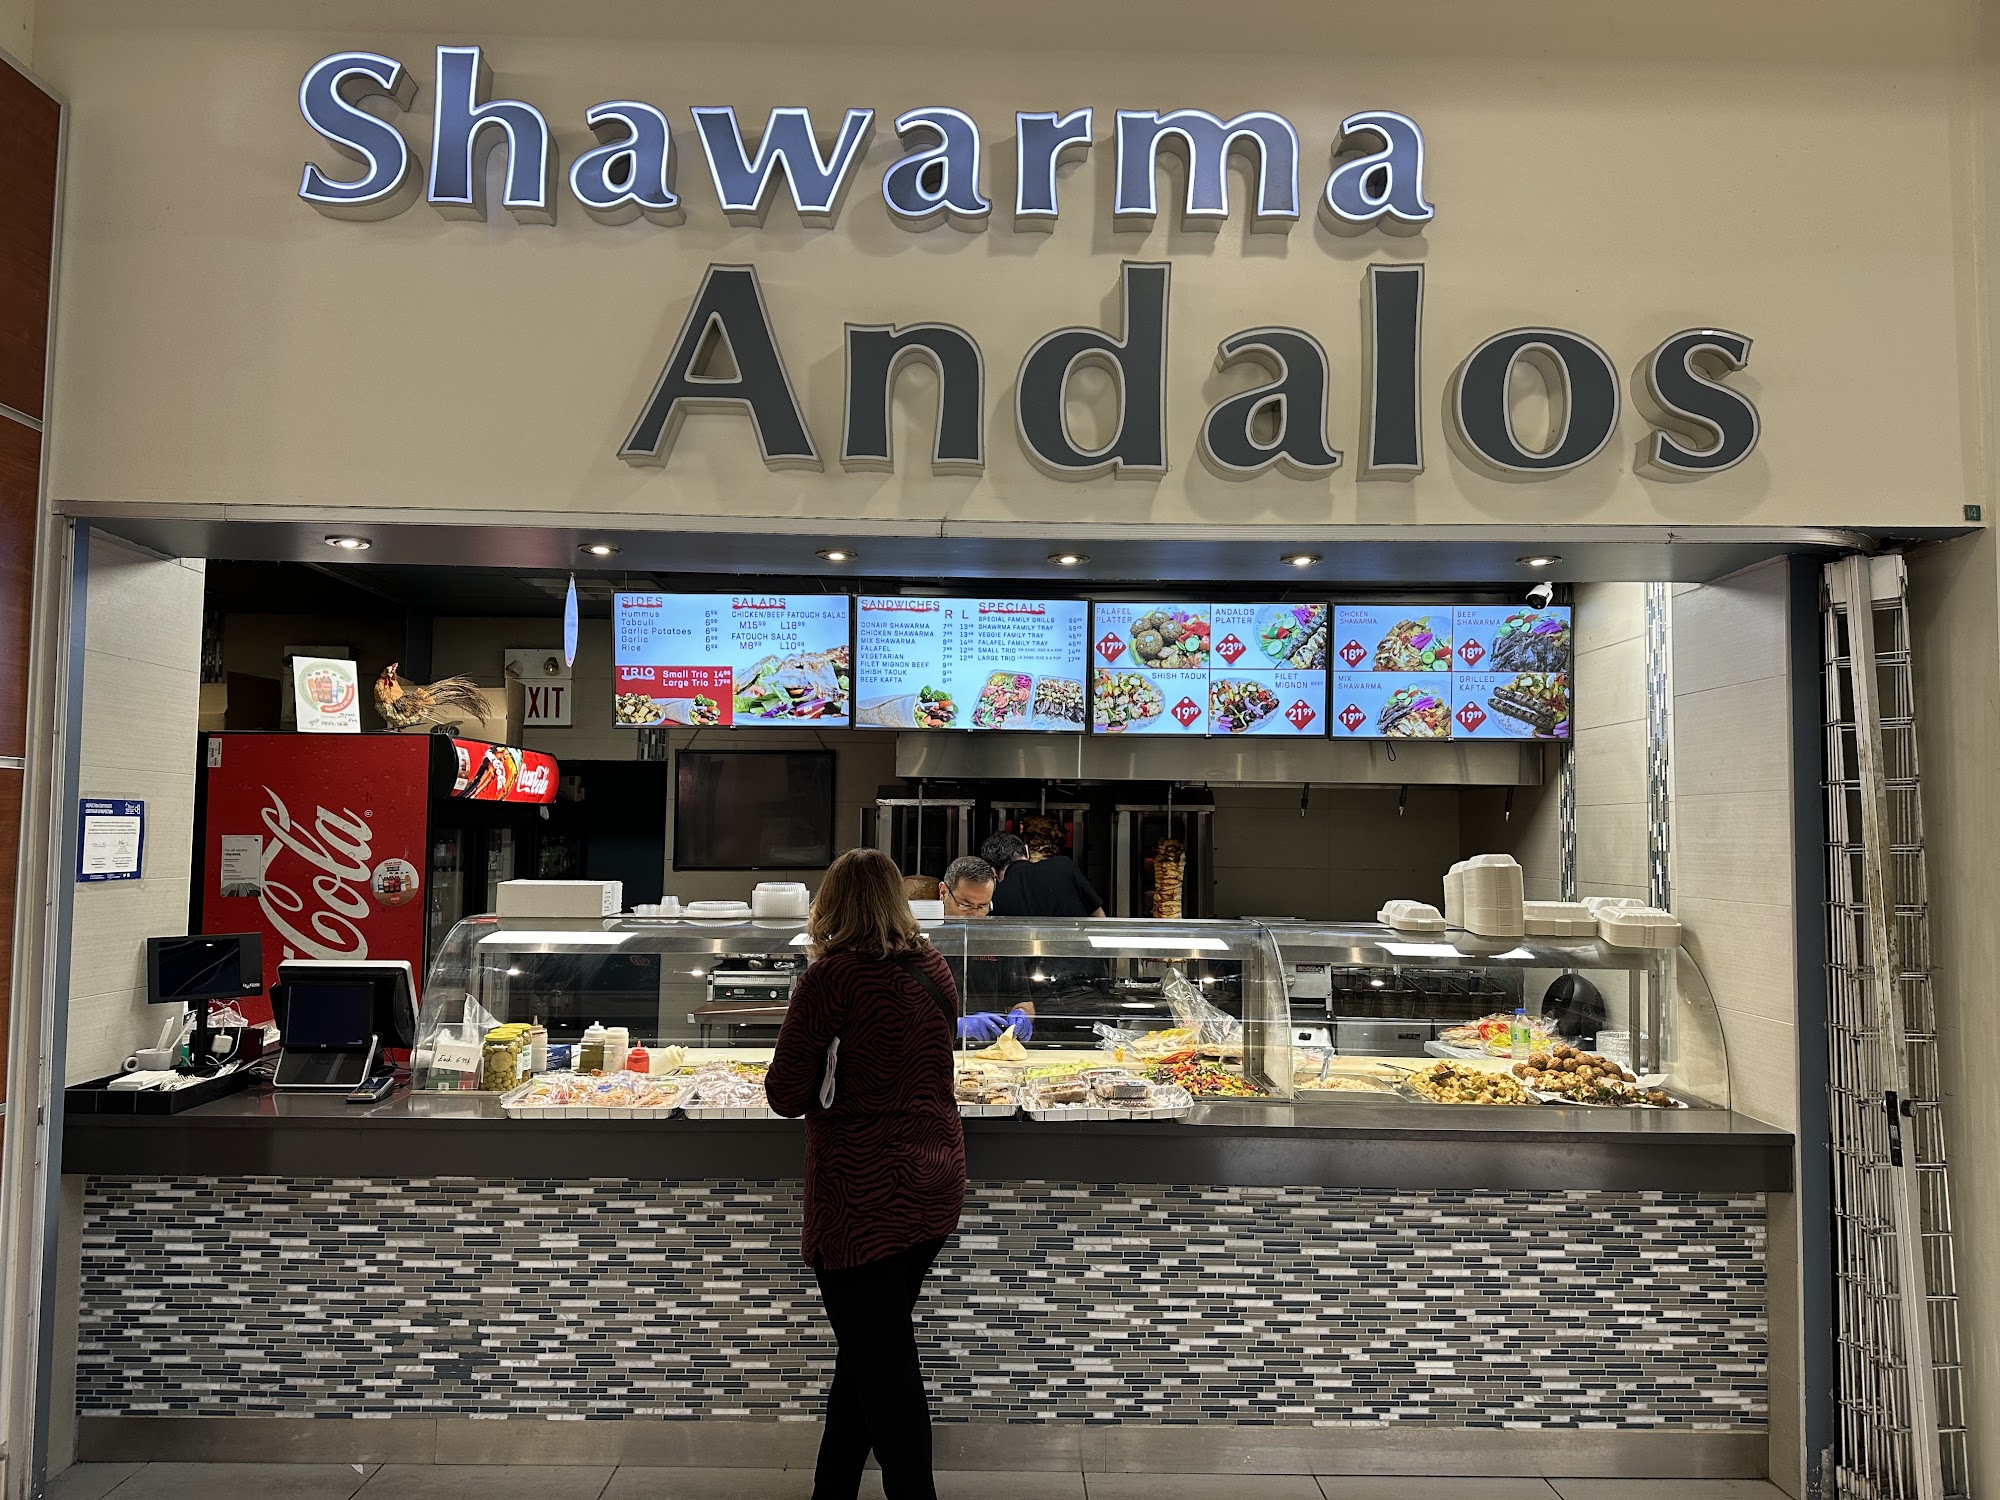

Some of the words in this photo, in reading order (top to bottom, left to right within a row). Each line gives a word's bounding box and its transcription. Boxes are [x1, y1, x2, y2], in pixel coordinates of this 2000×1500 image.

[298, 45, 1436, 222] Shawarma
[617, 260, 1763, 478] Andalos
[621, 596, 663, 607] SIDES
[732, 597, 786, 607] SALADS
[861, 599, 940, 609] SANDWICHES
[978, 602, 1046, 611] SPECIALS
[621, 610, 660, 618] Hummus
[787, 611, 820, 619] FATOUCH
[822, 611, 846, 619] SALAD
[945, 609, 953, 619] R
[962, 610, 969, 619] L
[621, 618, 654, 626] Tabouli
[621, 627, 648, 635] Garlic
[651, 627, 692, 635] Potatoes
[621, 635, 649, 643] Garlic
[621, 644, 641, 652] Rice
[621, 667, 655, 677] TRIO
[662, 670, 689, 678] Small
[691, 670, 709, 678] Trio
[662, 679, 689, 689] Large
[691, 679, 709, 687] Trio
[1275, 681, 1308, 689] MIGNON
[527, 686, 565, 719] XIT
